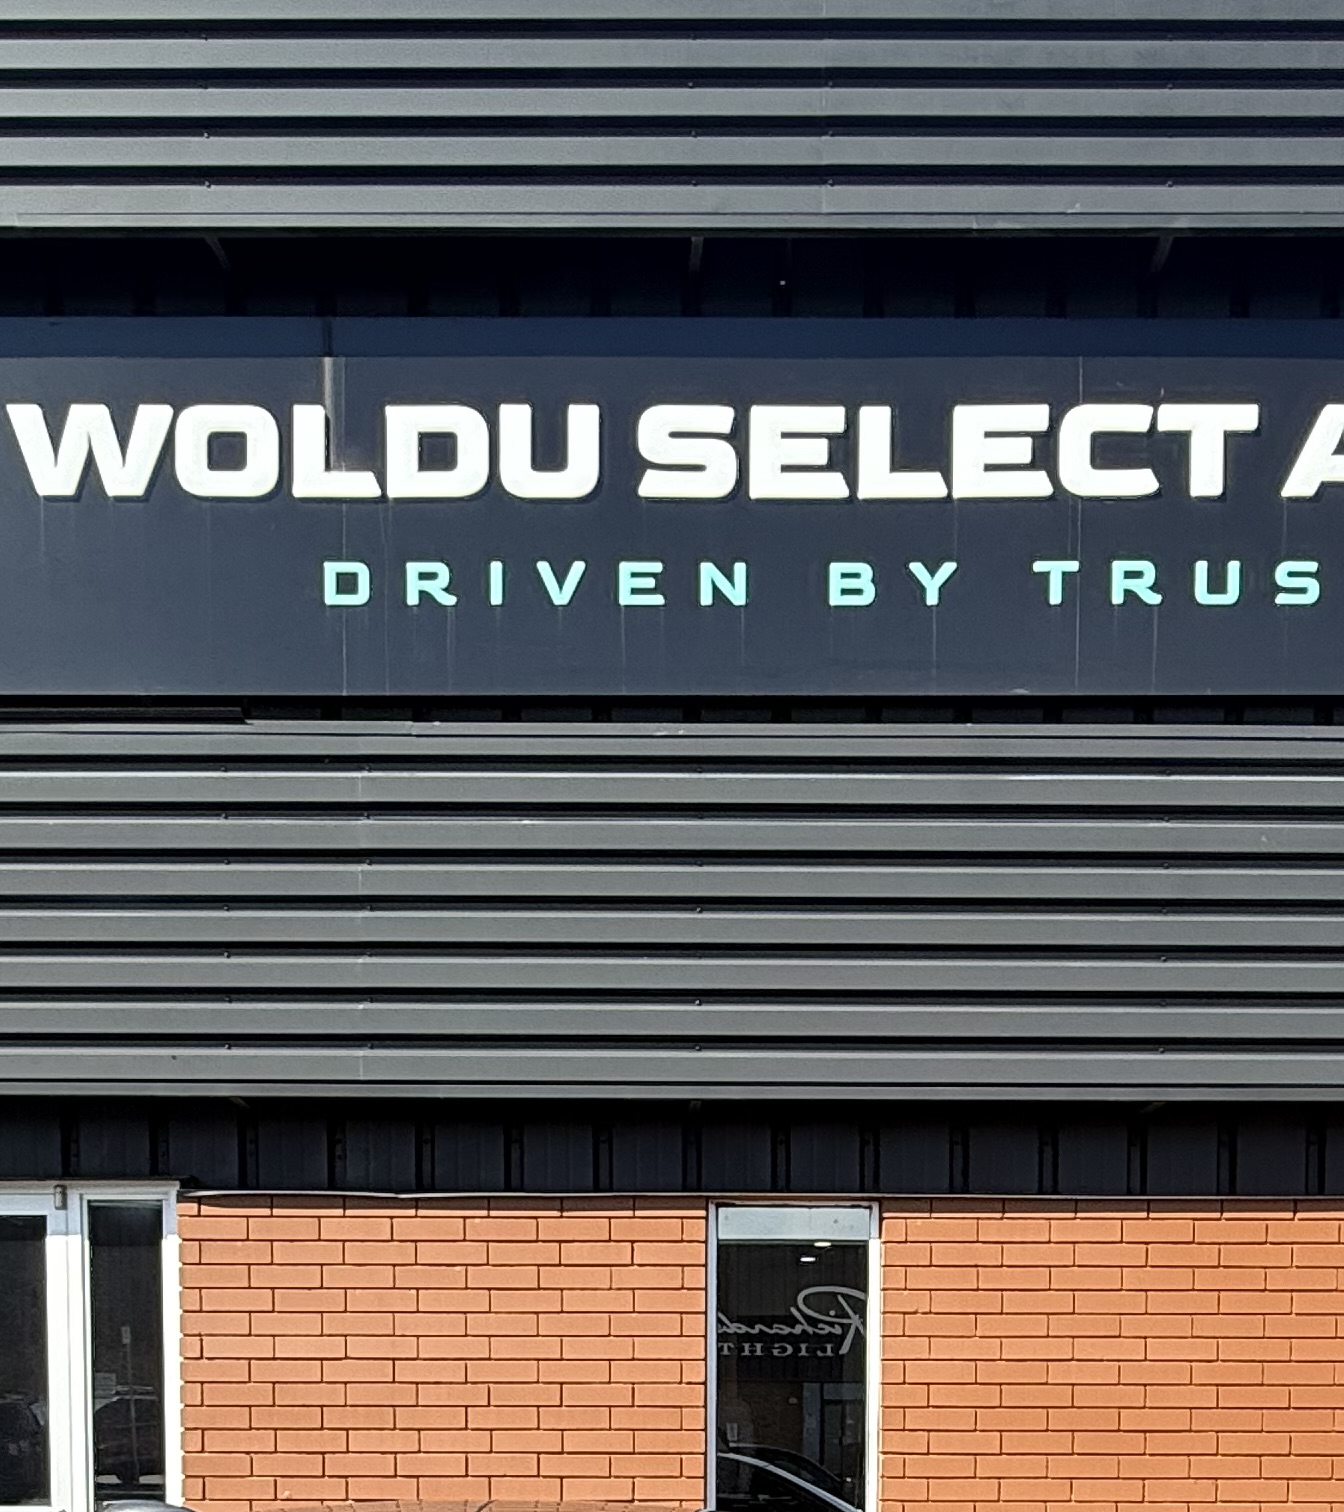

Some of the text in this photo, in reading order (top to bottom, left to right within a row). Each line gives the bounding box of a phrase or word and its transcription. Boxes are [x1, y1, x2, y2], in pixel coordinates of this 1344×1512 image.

[6, 403, 600, 499] WOLDU
[637, 403, 1259, 499] SELECT
[323, 560, 748, 606] DRIVEN
[828, 560, 958, 606] BY
